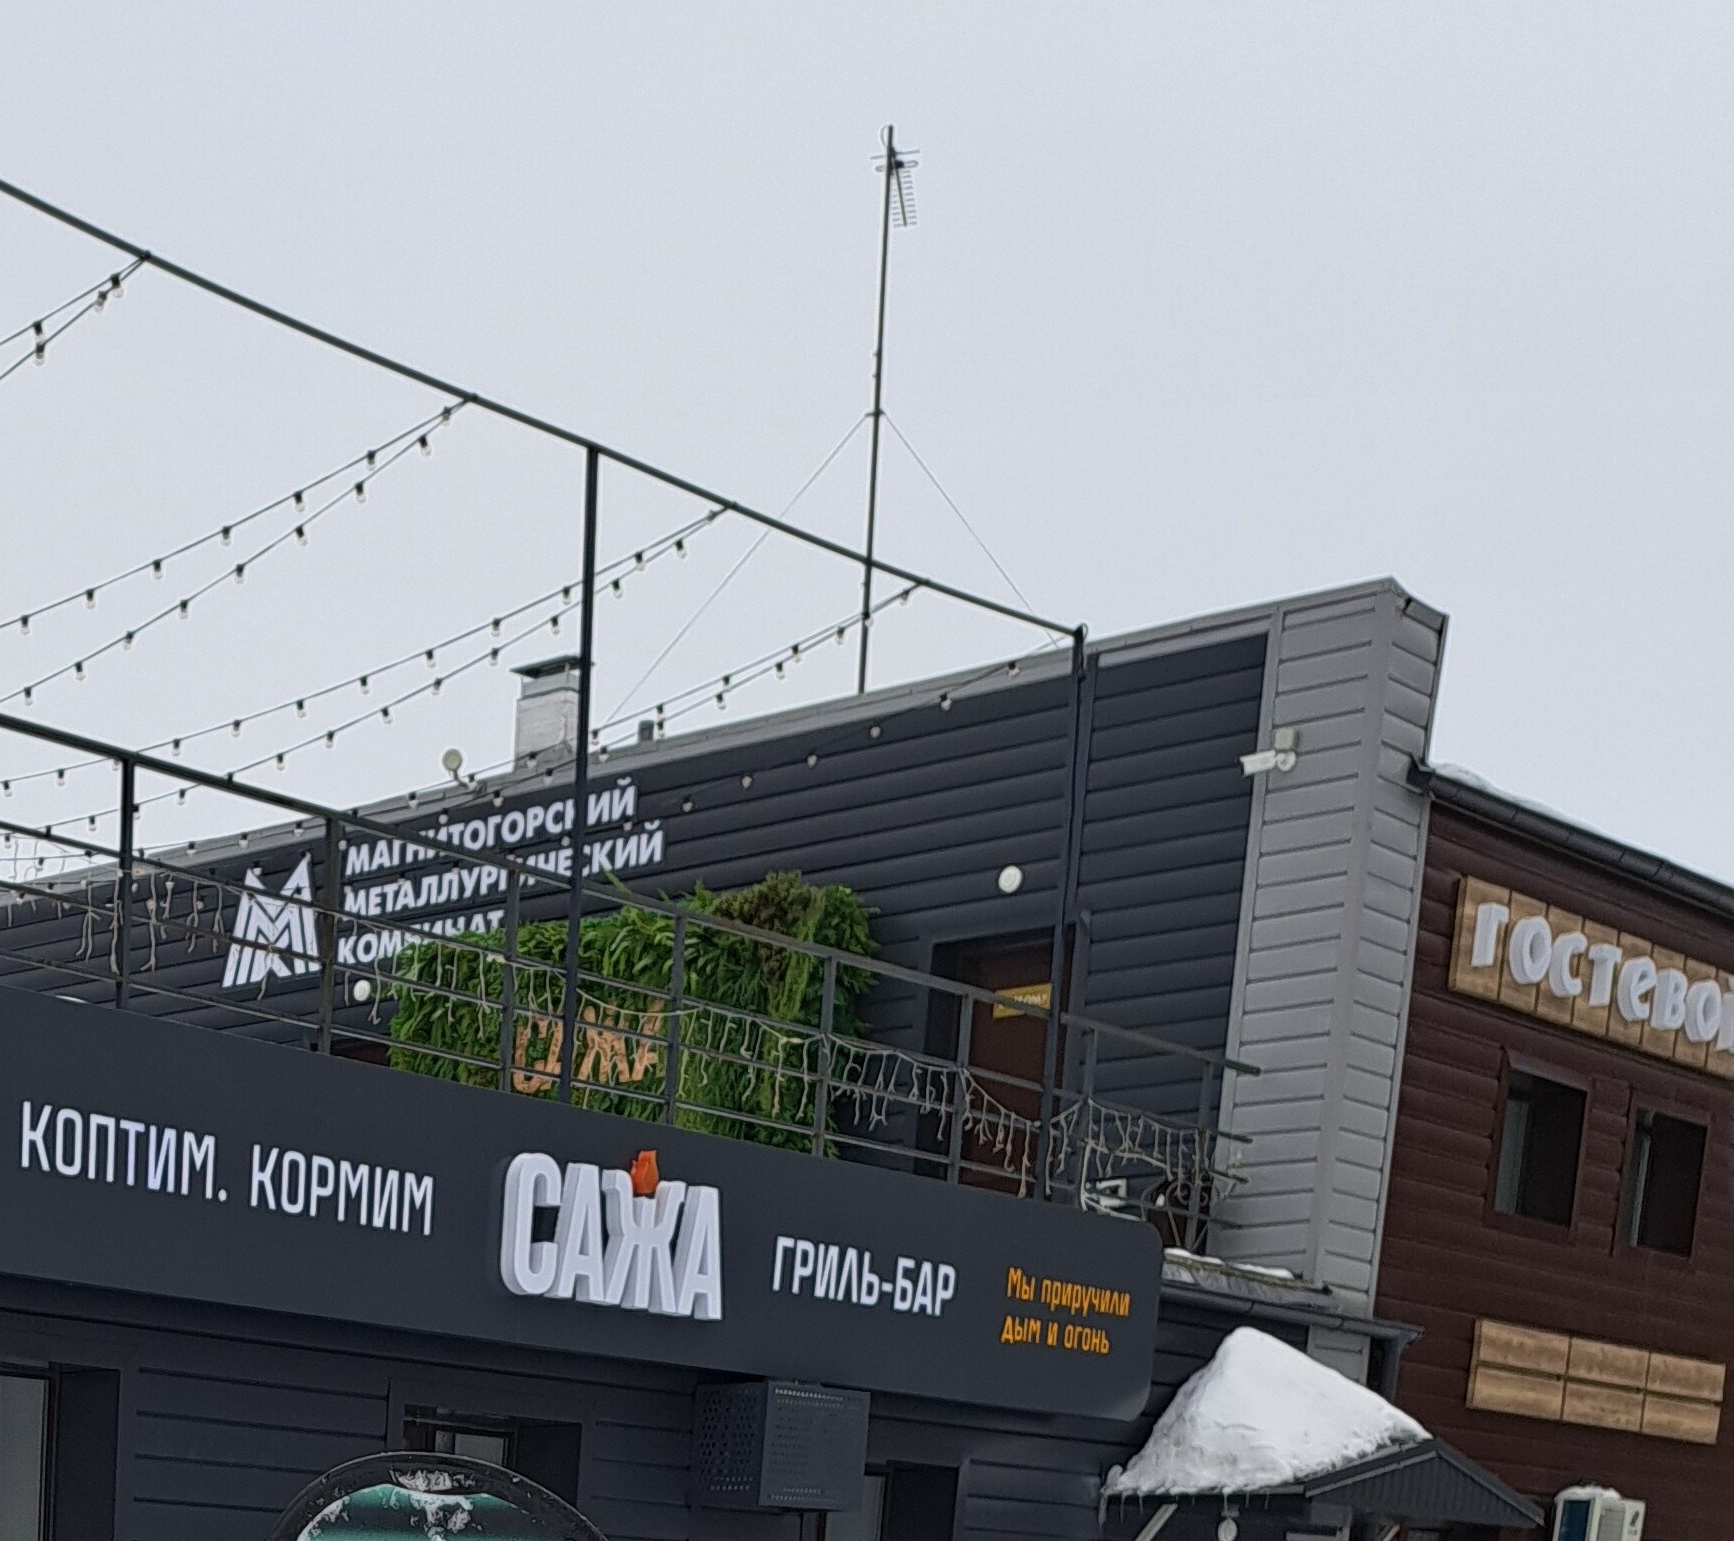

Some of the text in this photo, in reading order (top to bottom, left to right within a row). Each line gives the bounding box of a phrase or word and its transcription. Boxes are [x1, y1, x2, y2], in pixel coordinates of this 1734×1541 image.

[337, 909, 506, 965] КОМНАТ
[20, 1100, 229, 1203] КОПТИМ.
[249, 1143, 435, 1236] КОРМИМ
[499, 1151, 725, 1321] САЖА
[771, 1234, 958, 1318] ГРИЛЬ-БАР
[1007, 1266, 1131, 1318] Мы приручили
[1047, 1321, 1059, 1347] и
[1063, 1323, 1110, 1354] огонь
